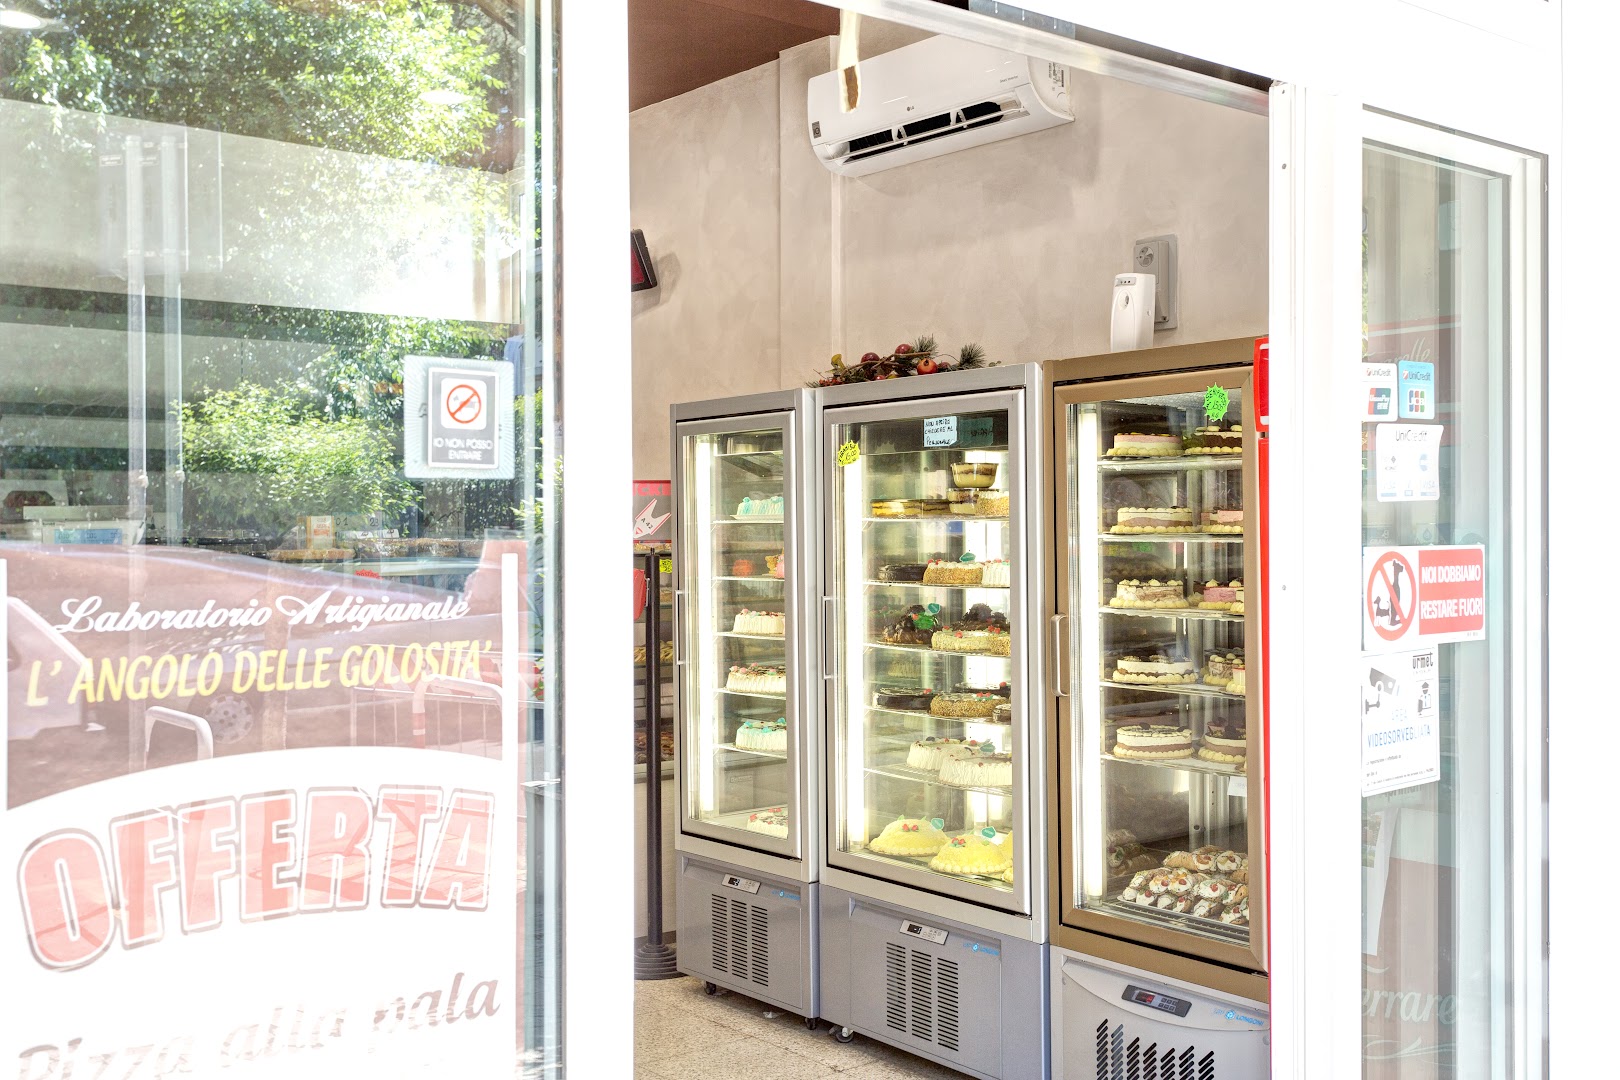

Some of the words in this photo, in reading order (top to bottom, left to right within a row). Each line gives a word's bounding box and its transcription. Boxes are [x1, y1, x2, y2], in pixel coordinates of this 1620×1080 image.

[1409, 371, 1432, 381] UniCredit
[433, 437, 444, 447] IO
[444, 438, 465, 448] NON
[466, 439, 493, 450] POSSO
[447, 450, 482, 460] ENTRARE
[1421, 566, 1437, 583] NOI
[1438, 565, 1481, 583] DOBBIAMO
[51, 595, 272, 634] Laboratorio
[275, 589, 472, 633] Artigianale
[1420, 599, 1458, 619] RESTARE
[1459, 597, 1483, 617] FUORI
[1412, 652, 1433, 669] urmet
[68, 651, 224, 704] ANGOLO
[231, 646, 332, 694] DELLE
[339, 640, 493, 687] GOLOSITA'
[1367, 725, 1431, 749] VIDEOSORVEGLIATA
[17, 784, 497, 973] OFFERTA
